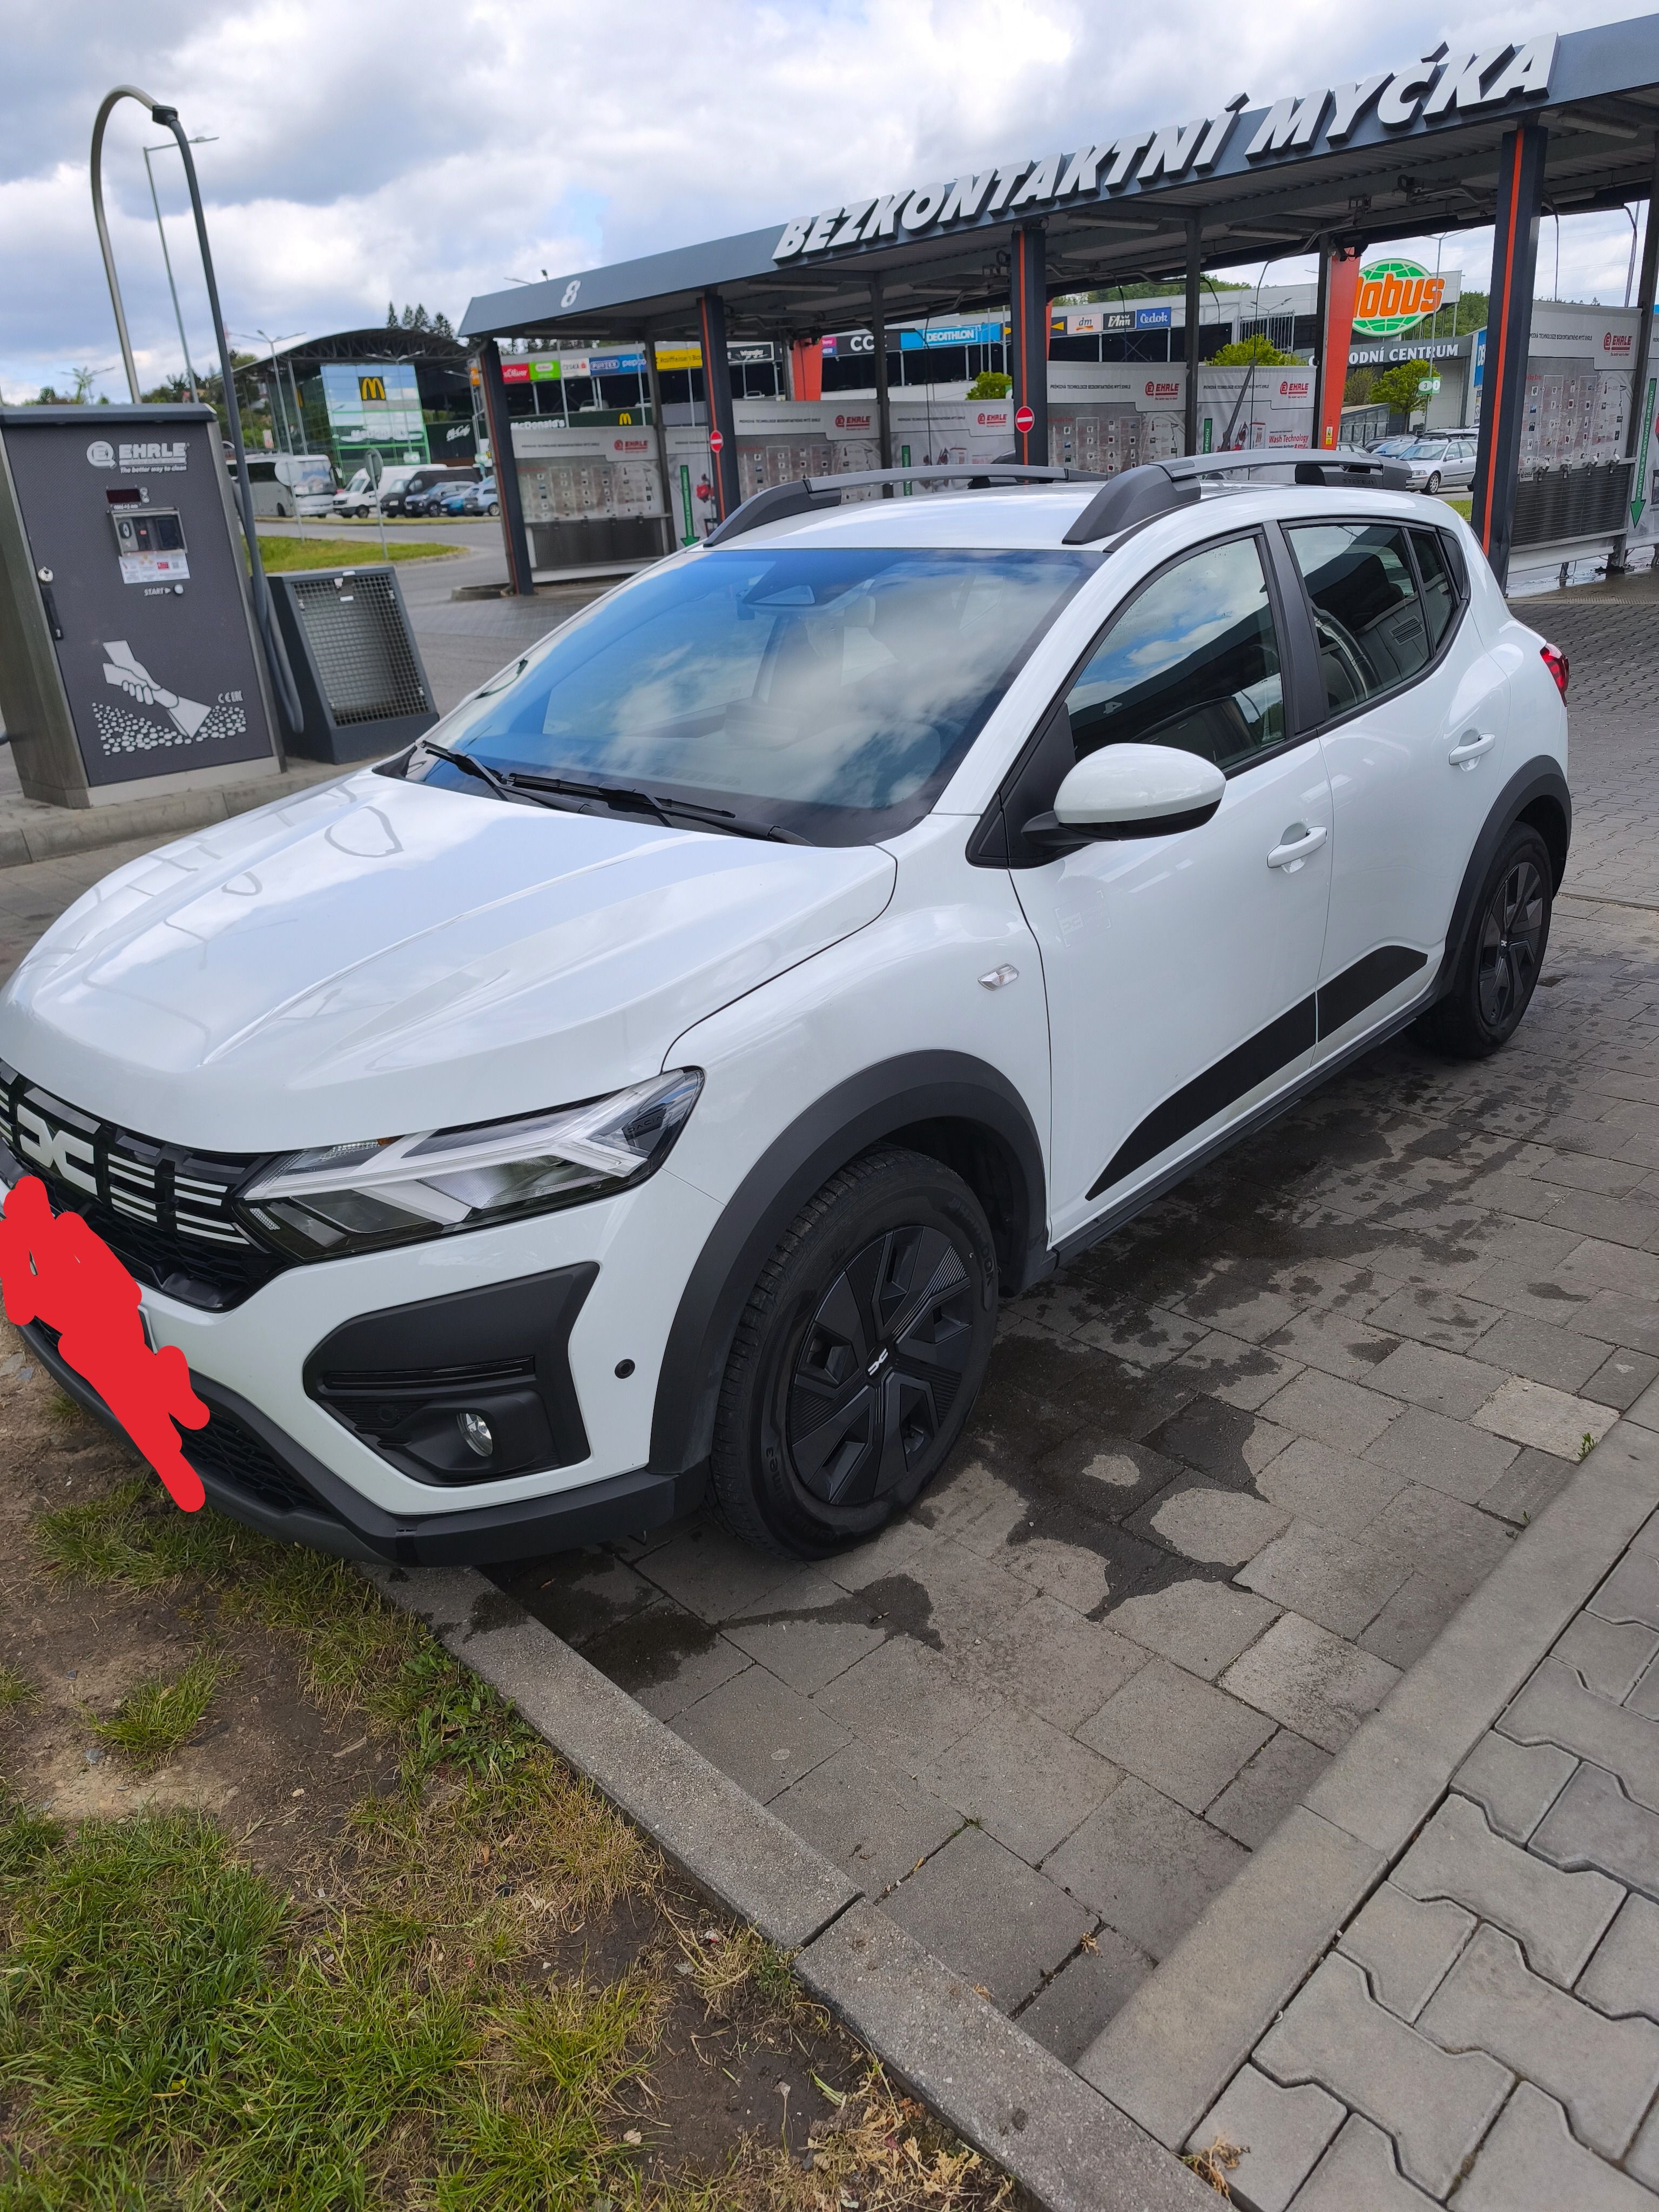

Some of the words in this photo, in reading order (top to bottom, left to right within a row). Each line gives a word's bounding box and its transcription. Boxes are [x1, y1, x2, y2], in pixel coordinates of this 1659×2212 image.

[772, 92, 1247, 264] BEZKONTAKTNÍ
[1245, 32, 1560, 163] MYČKA
[561, 280, 581, 308] 8
[1353, 273, 1445, 318] lobus
[1078, 318, 1092, 326] dm
[1139, 312, 1168, 324] Čedok
[927, 330, 974, 342] DECATHLON
[1612, 335, 1633, 346] EHRLE
[1390, 344, 1459, 362] CENTRUM
[1156, 383, 1179, 392] EHRLE
[1289, 382, 1309, 390] EHRLE
[1269, 434, 1283, 443] Wash
[1283, 434, 1309, 443] Technology
[119, 442, 186, 460] EHRLE
[131, 466, 150, 474] better
[144, 587, 164, 597] START
